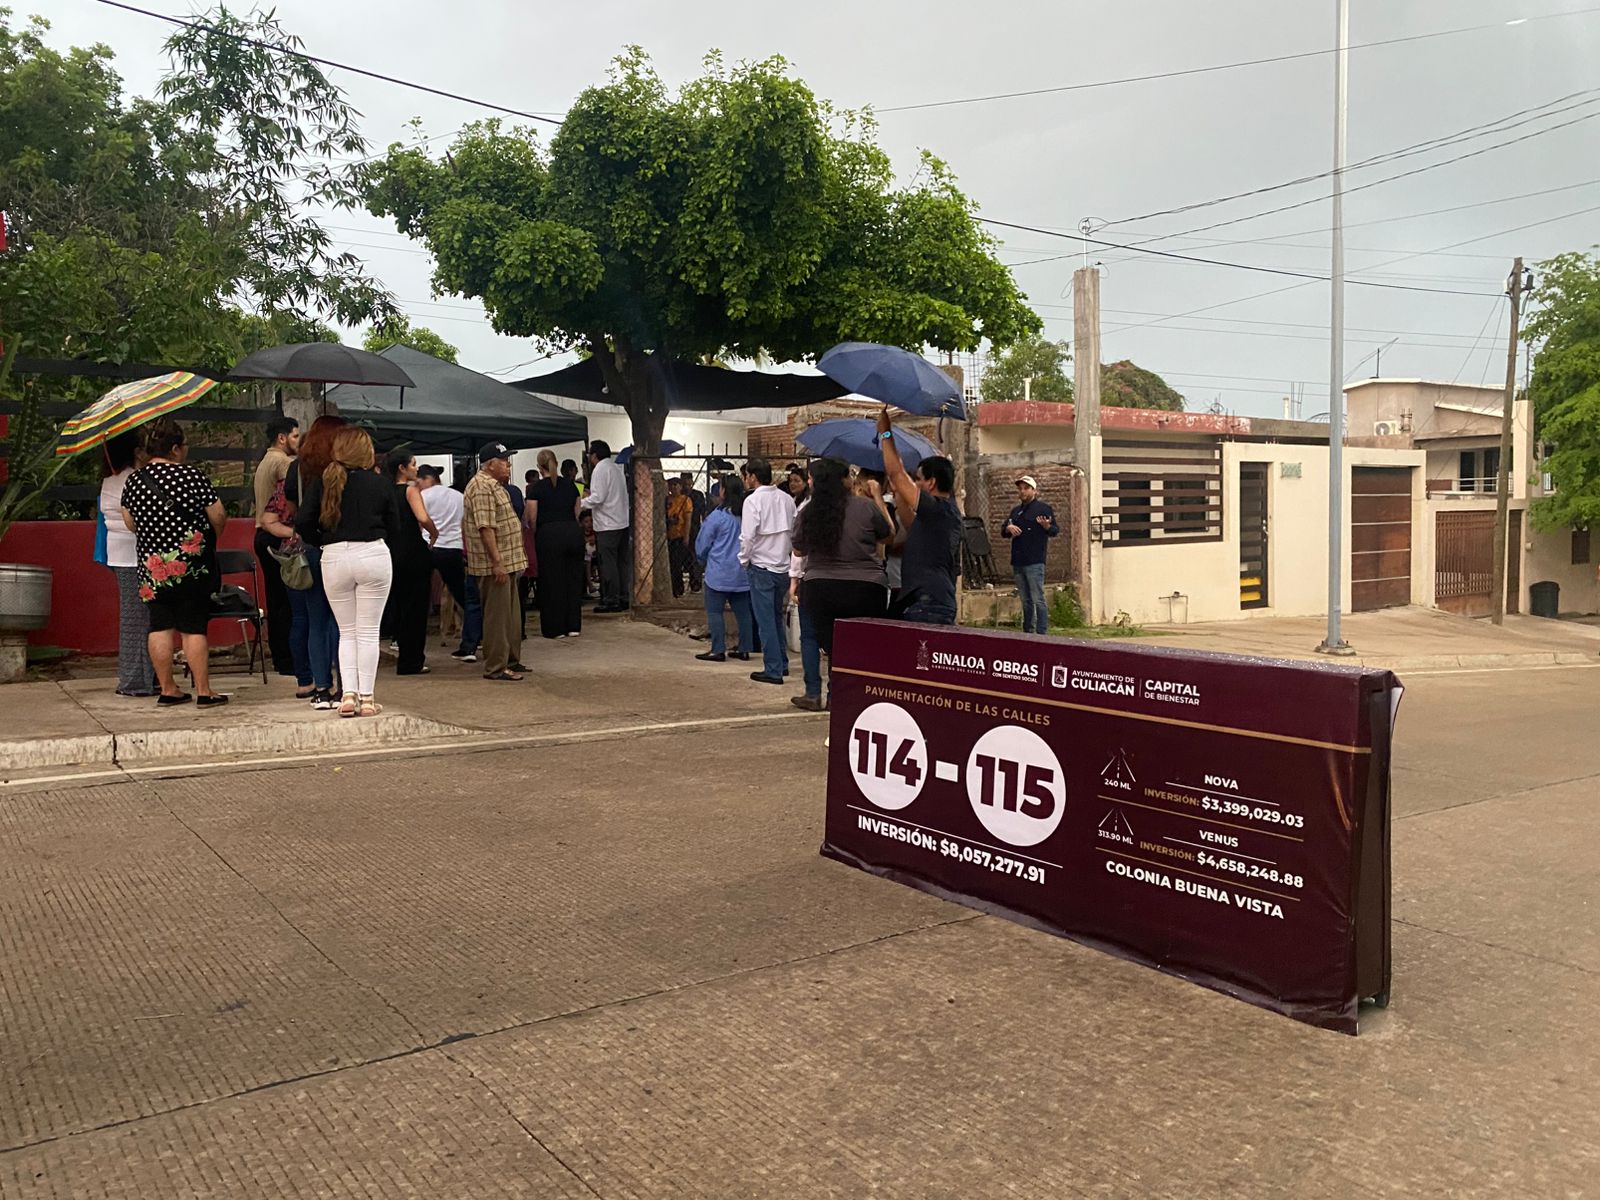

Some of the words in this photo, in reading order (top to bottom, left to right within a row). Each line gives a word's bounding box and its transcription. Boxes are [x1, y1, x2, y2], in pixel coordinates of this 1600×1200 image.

[932, 651, 985, 670] SINALOA
[992, 659, 1039, 677] OBRAS
[1072, 669, 1123, 682] AYUNTAMIENTO
[1124, 676, 1135, 684] DE
[1071, 677, 1135, 697] CULIACÁN
[1145, 679, 1200, 697] CAPITAL
[865, 685, 952, 708] PAVIMENTACIÓN
[956, 700, 971, 713] DE
[975, 704, 998, 717] LAS
[1002, 708, 1051, 727] CALLES
[1144, 691, 1156, 700] DE
[1156, 694, 1200, 706] BIENESTAR
[854, 728, 922, 787] 114
[976, 753, 1055, 820] 115
[1204, 774, 1239, 790] NOVA
[1104, 778, 1119, 788] 240
[1120, 781, 1132, 791] ML
[1144, 787, 1200, 807] INVERSIÓN:
[1201, 795, 1304, 828] $3,399,029.03
[1097, 829, 1121, 841] 313.90
[1122, 835, 1134, 845] ML
[1199, 829, 1239, 848] VENUS
[857, 814, 937, 851] INVERSIÓN:
[939, 838, 1046, 885] $8,057,277.91
[1140, 840, 1195, 862] INVERSIÓN:
[1197, 850, 1304, 889] $4,658,248.88
[1105, 860, 1172, 890] COLONIA
[1175, 878, 1231, 906] BUENA
[1234, 893, 1285, 921] VISTA
